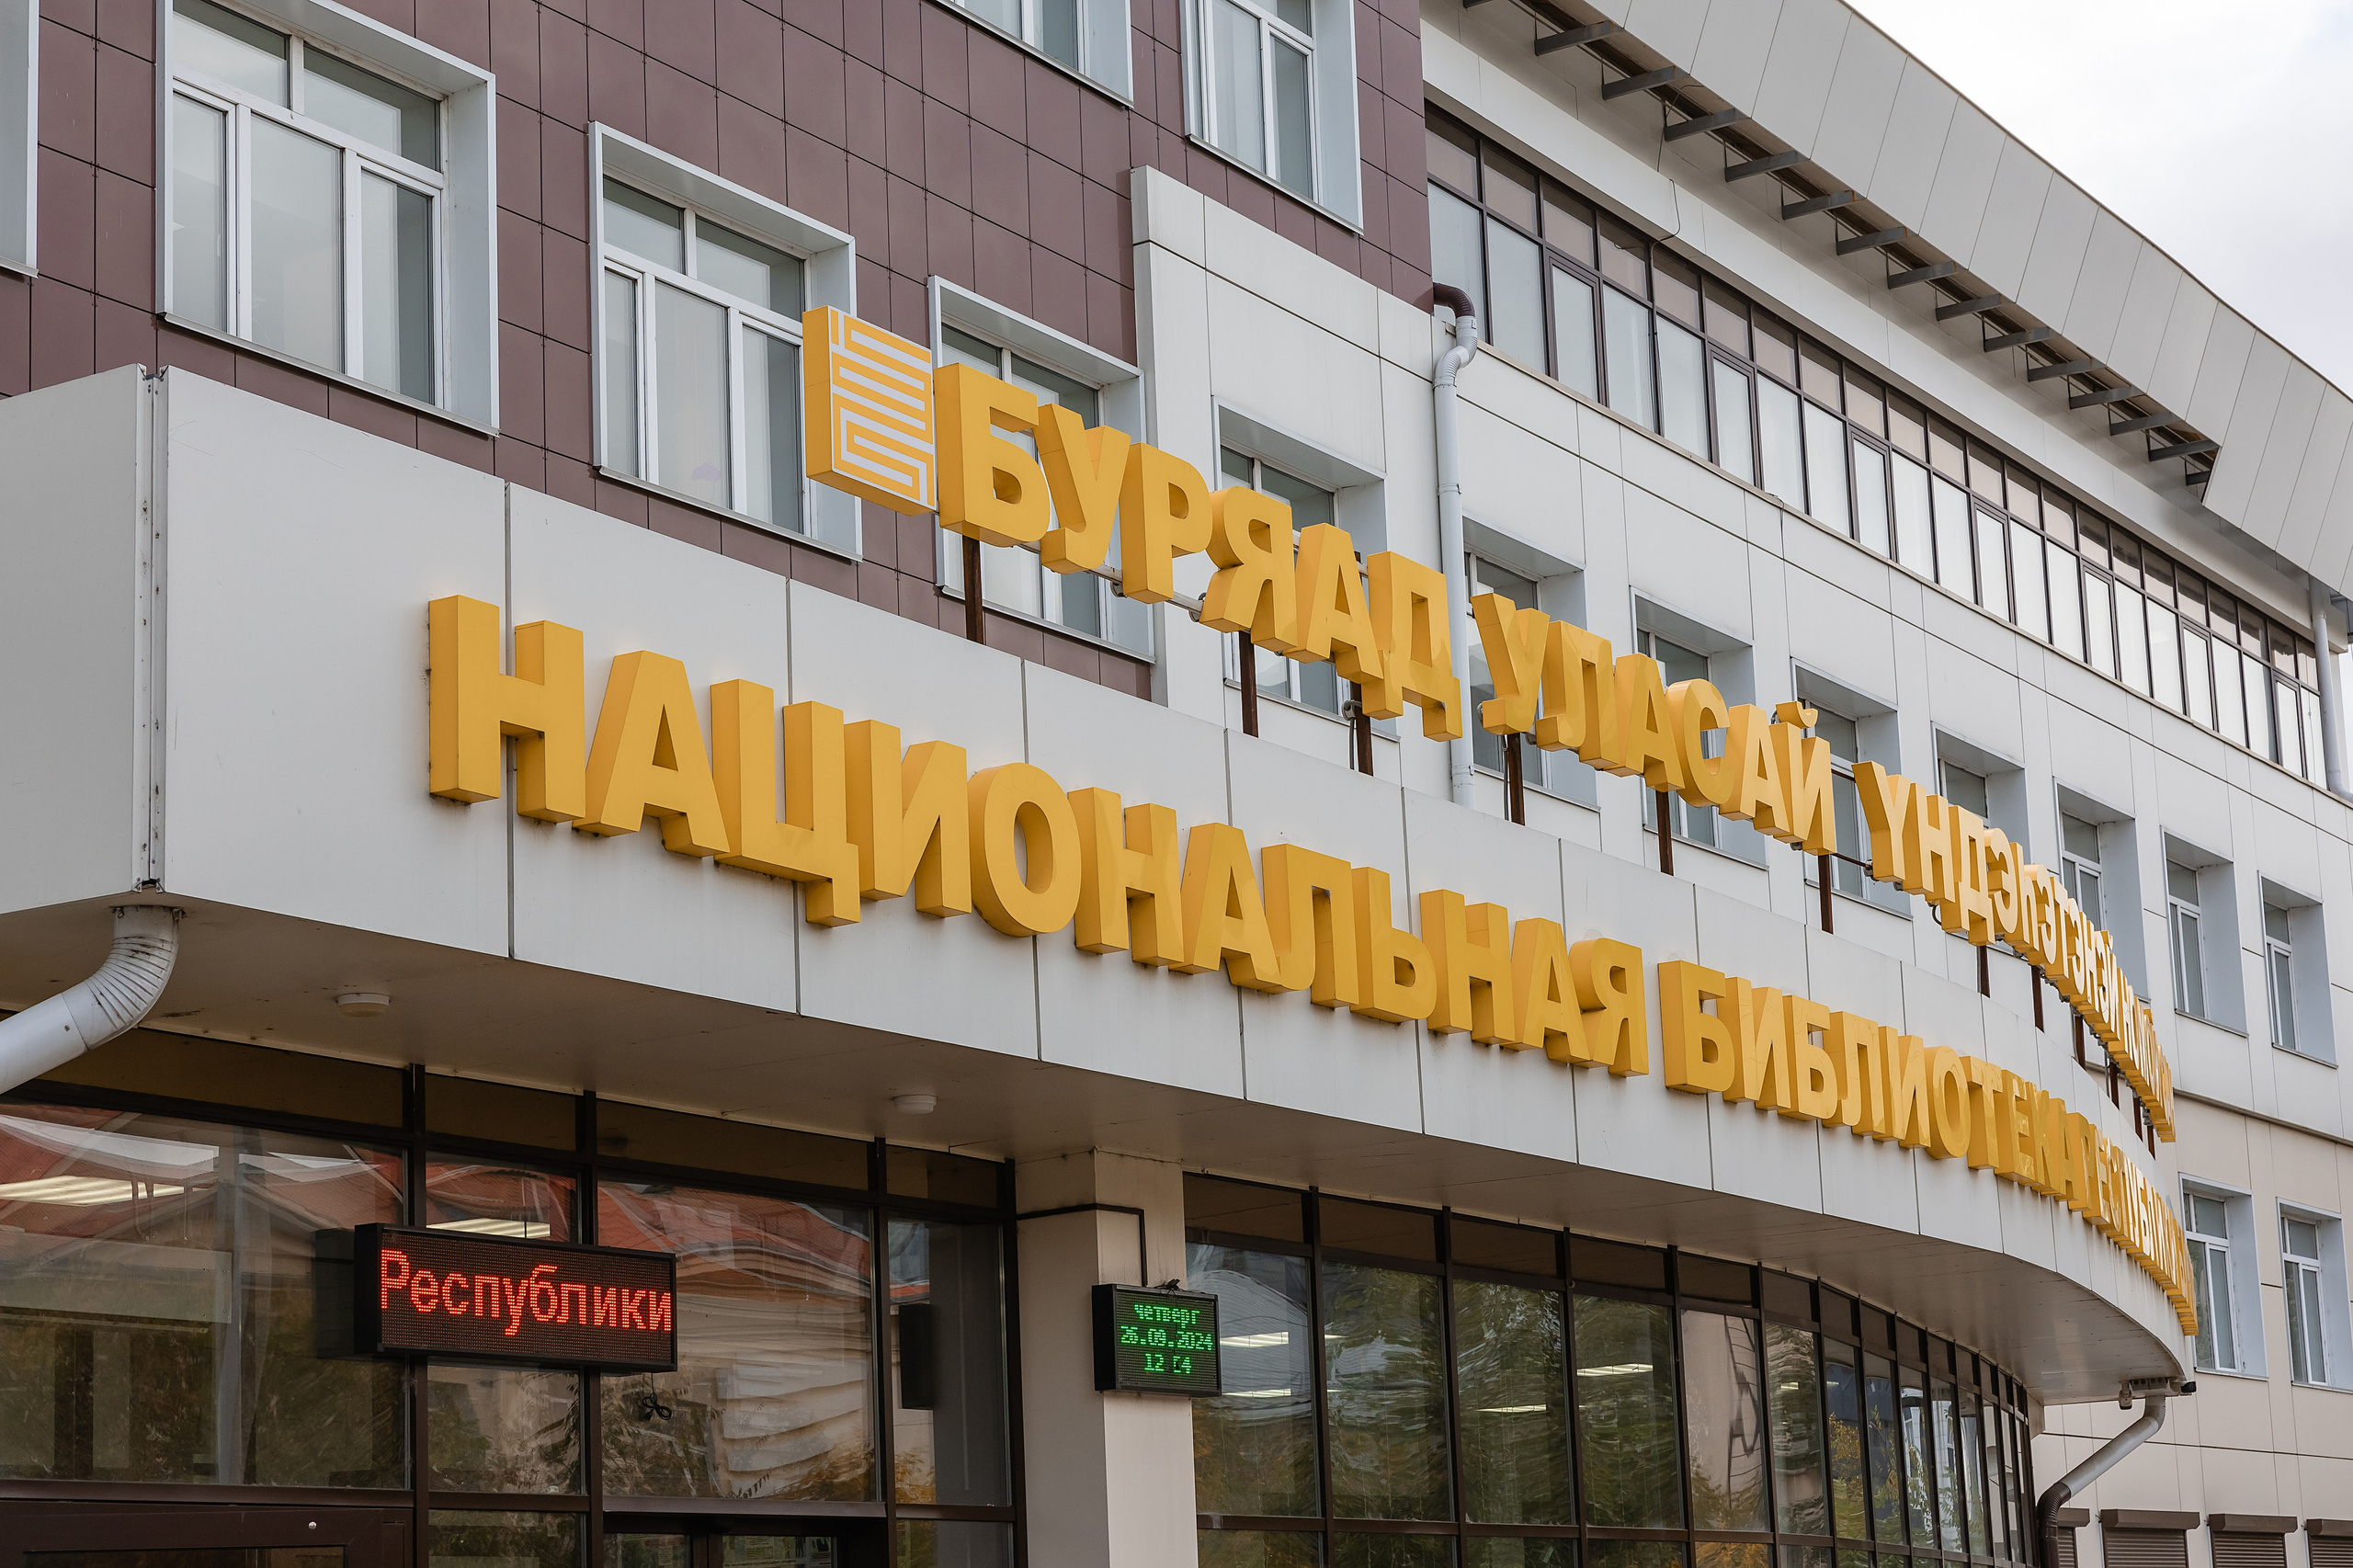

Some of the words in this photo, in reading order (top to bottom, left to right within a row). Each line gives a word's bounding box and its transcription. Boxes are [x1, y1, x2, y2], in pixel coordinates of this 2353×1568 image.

[933, 363, 1463, 742] БУРЯАД
[1471, 592, 1836, 856] УЛАСАЙ
[428, 594, 1649, 1077] НАЦИОНАЛЬНАЯ
[1658, 960, 2078, 1201] БИБЛИОТЕКА
[2067, 1111, 2180, 1291] РЕСПУБЛИКИ
[381, 1248, 672, 1336] Республики
[1133, 1304, 1200, 1328] четверг
[1120, 1325, 1213, 1351] 26.09.2024
